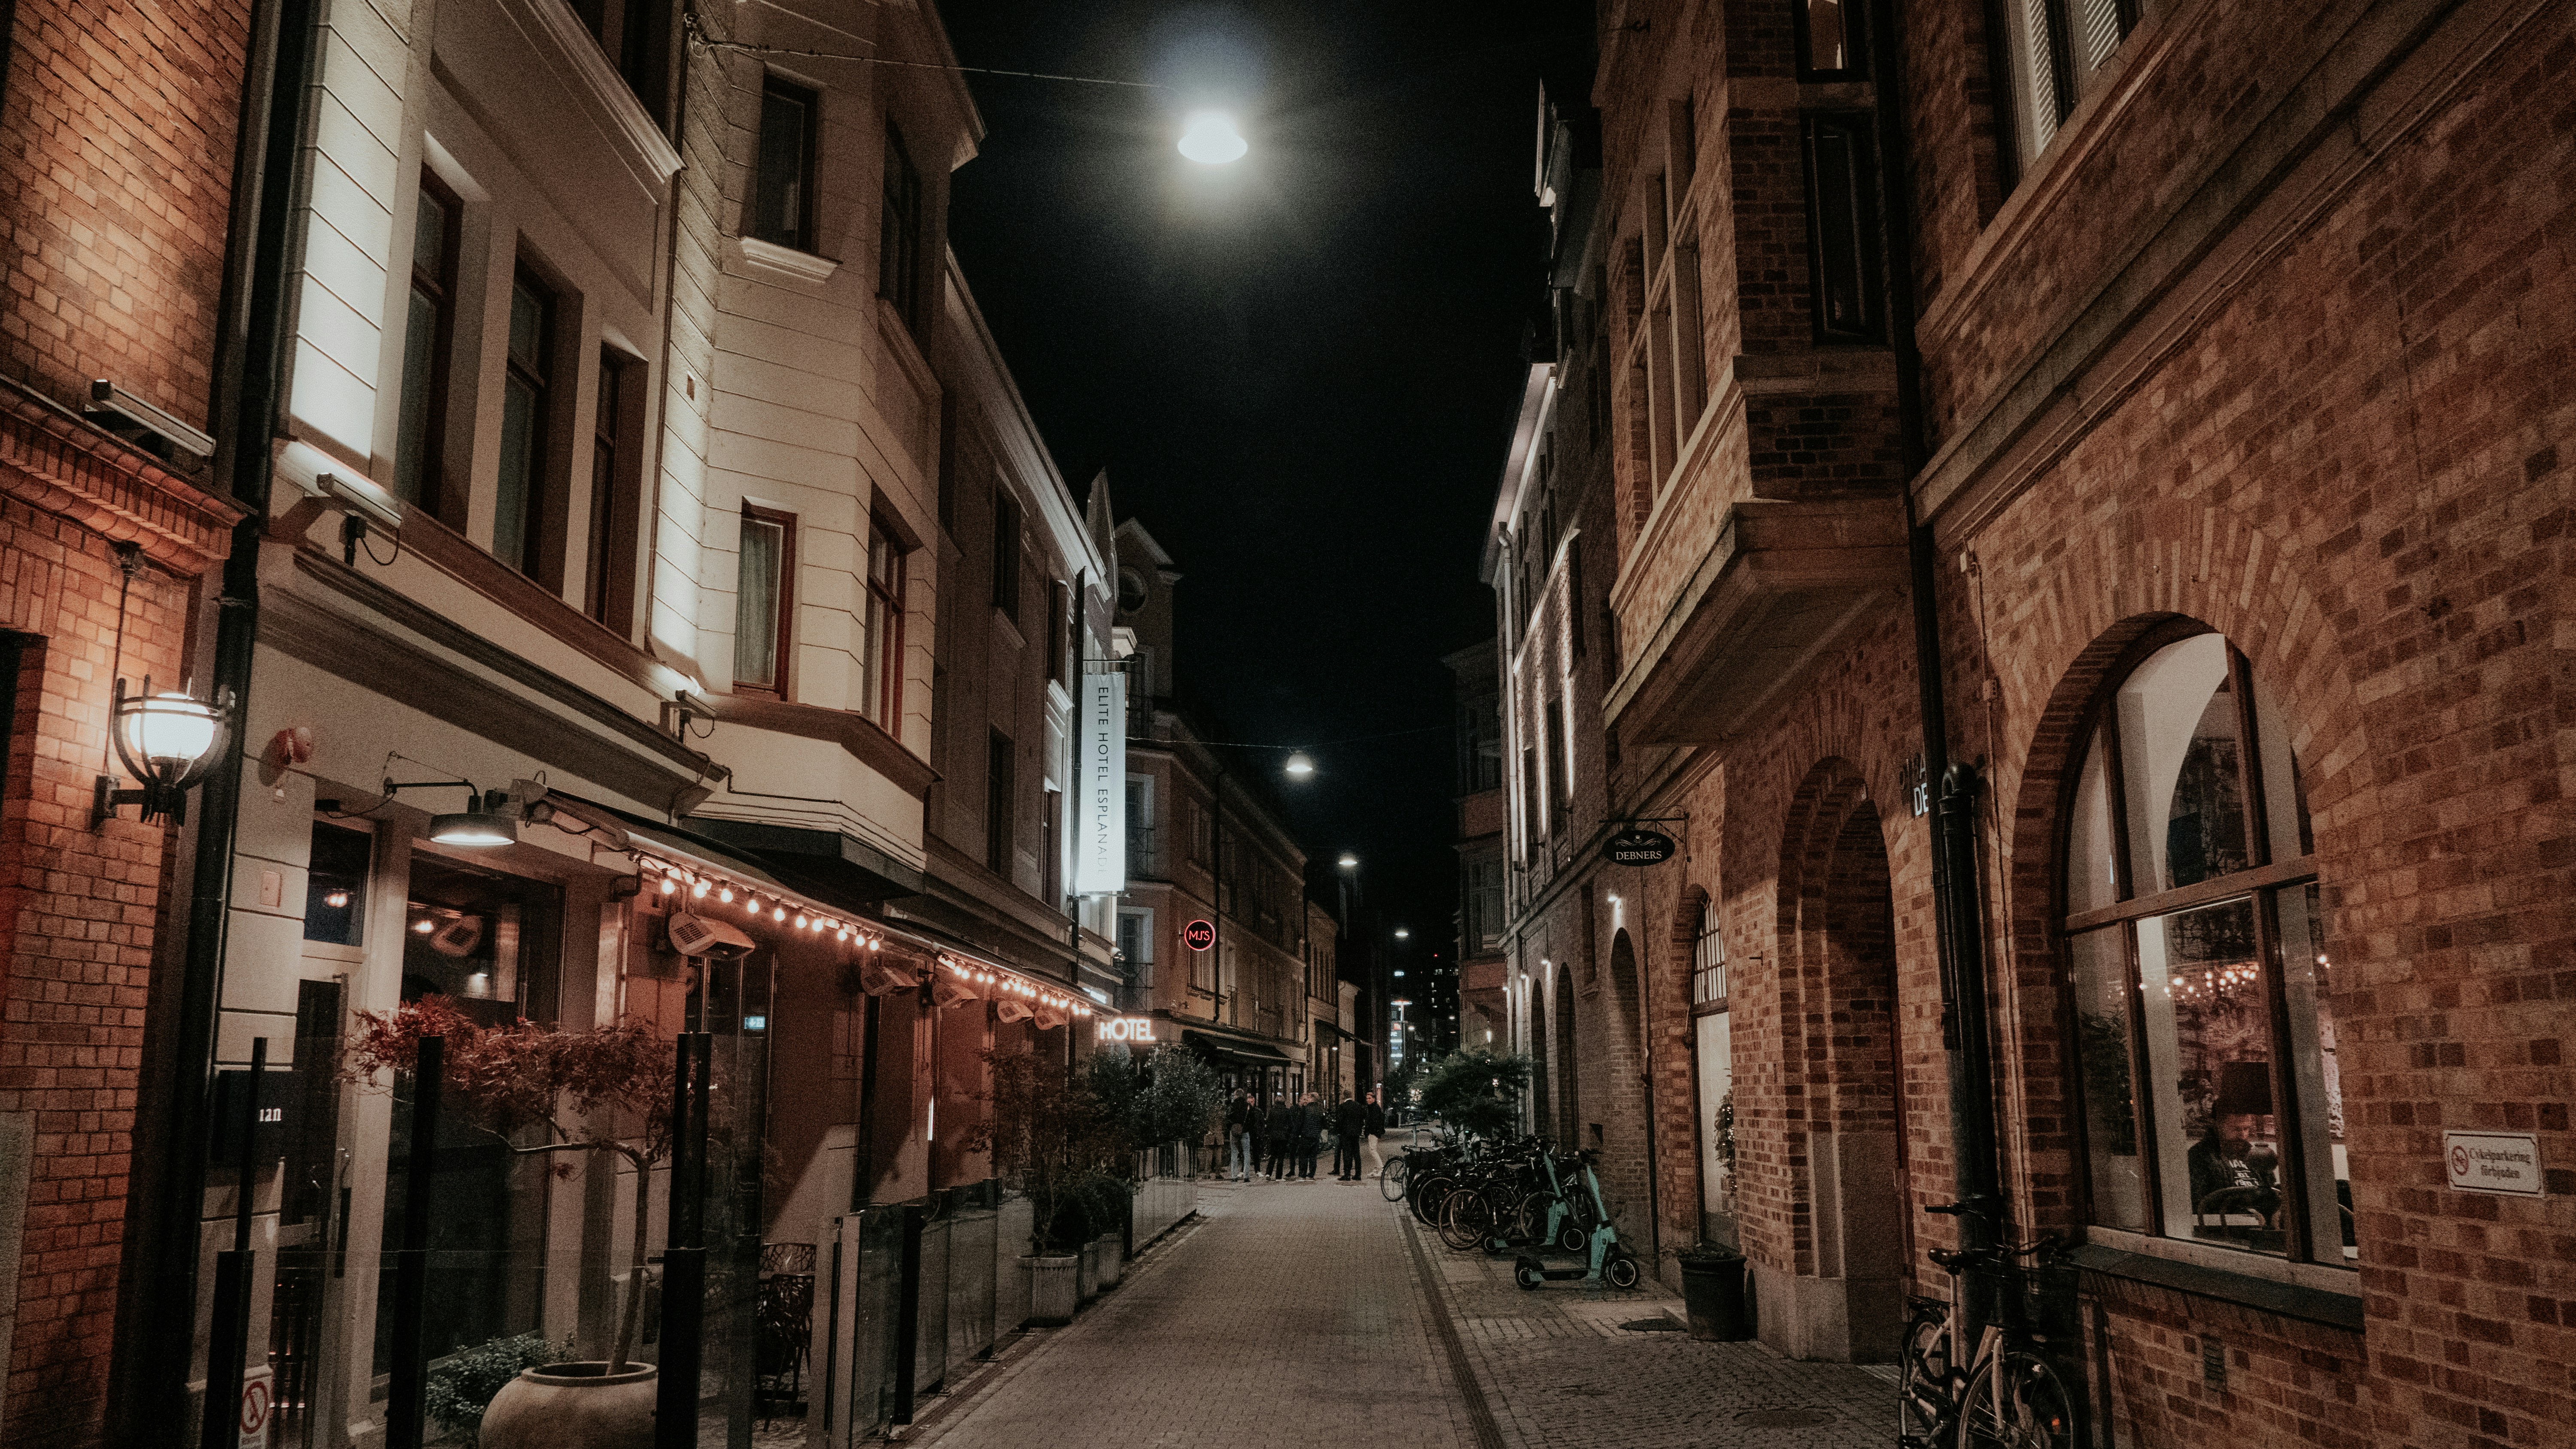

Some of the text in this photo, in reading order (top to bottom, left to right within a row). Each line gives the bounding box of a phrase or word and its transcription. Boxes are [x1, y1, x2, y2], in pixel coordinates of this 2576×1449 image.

[1098, 687, 1109, 725] ELITE
[1098, 733, 1108, 781] HOTEL
[1616, 851, 1662, 860] DEBNERS
[1189, 931, 1210, 941] MJ'S
[1100, 1018, 1156, 1040] HOTEL
